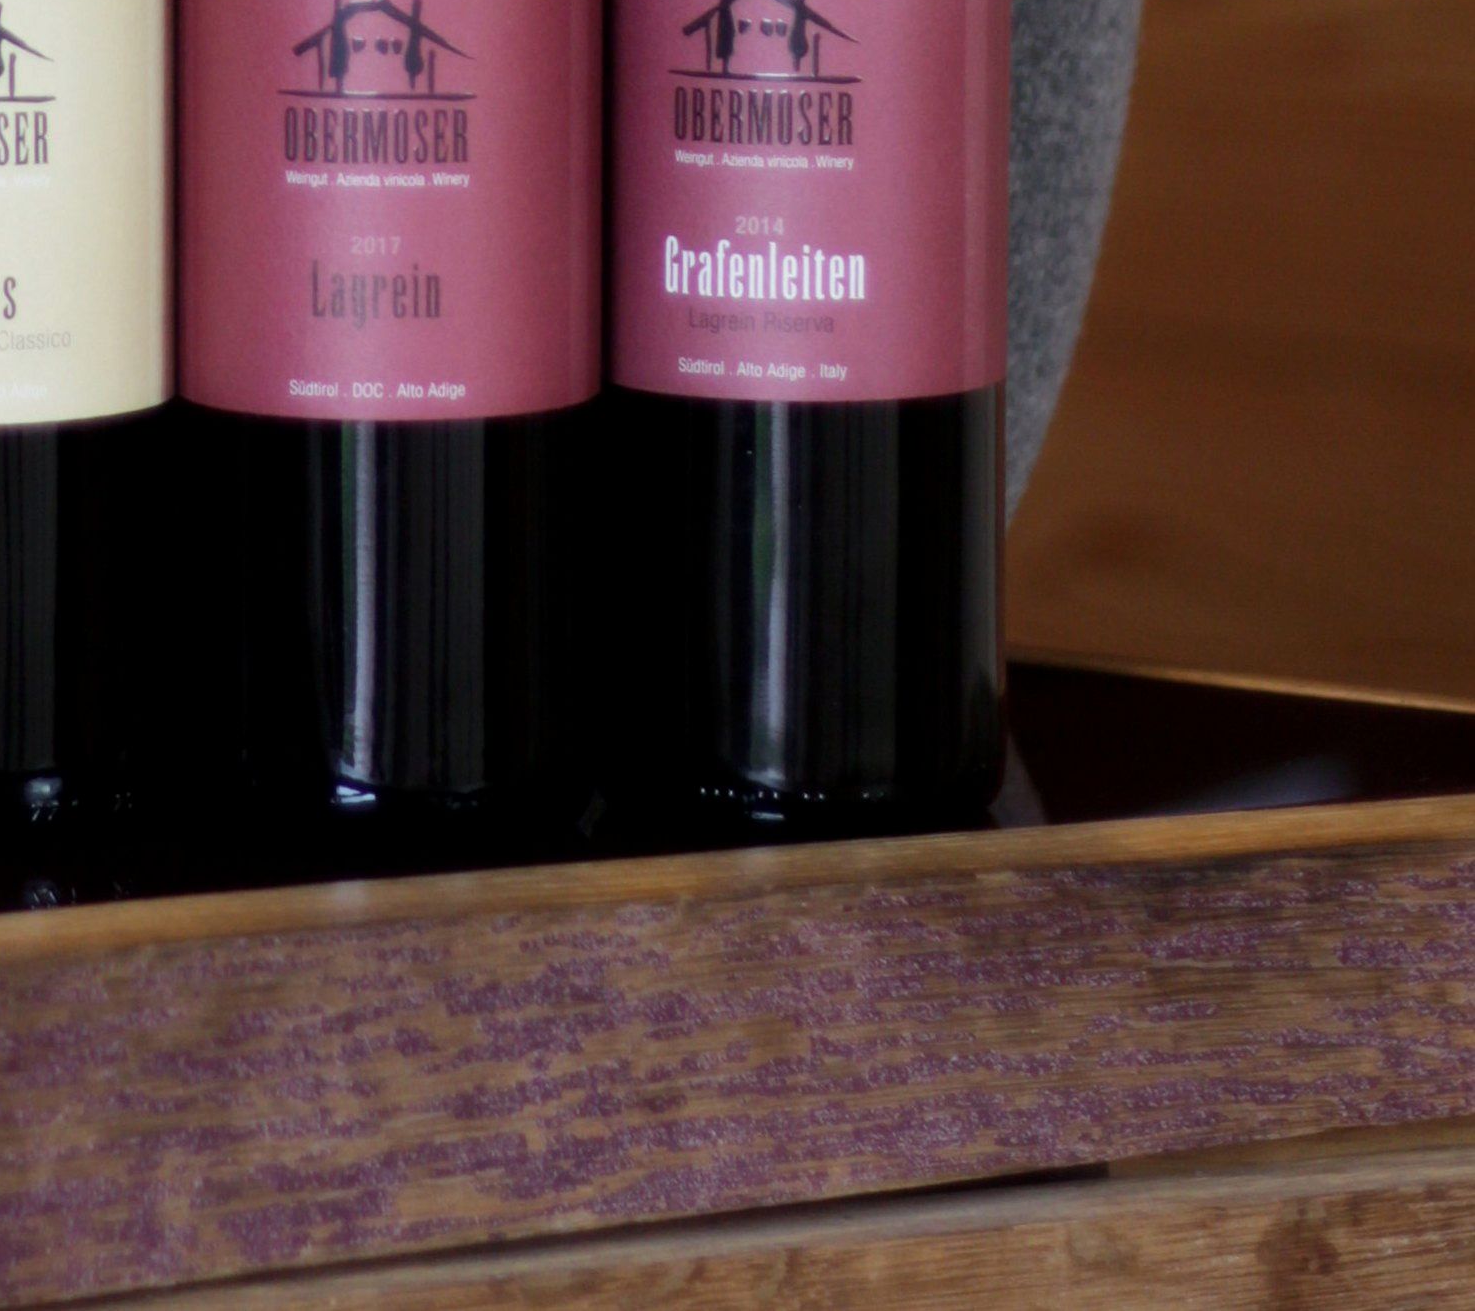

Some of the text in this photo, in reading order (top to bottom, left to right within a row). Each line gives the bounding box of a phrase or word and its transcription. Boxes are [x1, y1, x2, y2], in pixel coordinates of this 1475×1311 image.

[674, 86, 853, 145] OBERMOSER
[284, 106, 469, 164] OBERMOSER
[675, 149, 854, 171] Weingut Azienda vinicola Winery
[285, 170, 470, 188] Weingut Azienda vinicola Winery
[735, 216, 784, 235] 2014
[350, 236, 402, 255] 2017
[664, 234, 866, 301] Grafenleiten
[311, 259, 441, 330] Lagrein
[688, 306, 835, 334] Lagrein Riserva
[678, 356, 848, 382] Südtirol Alto Adige Italy
[289, 379, 466, 400] Südtirol DOC Alto Adige
